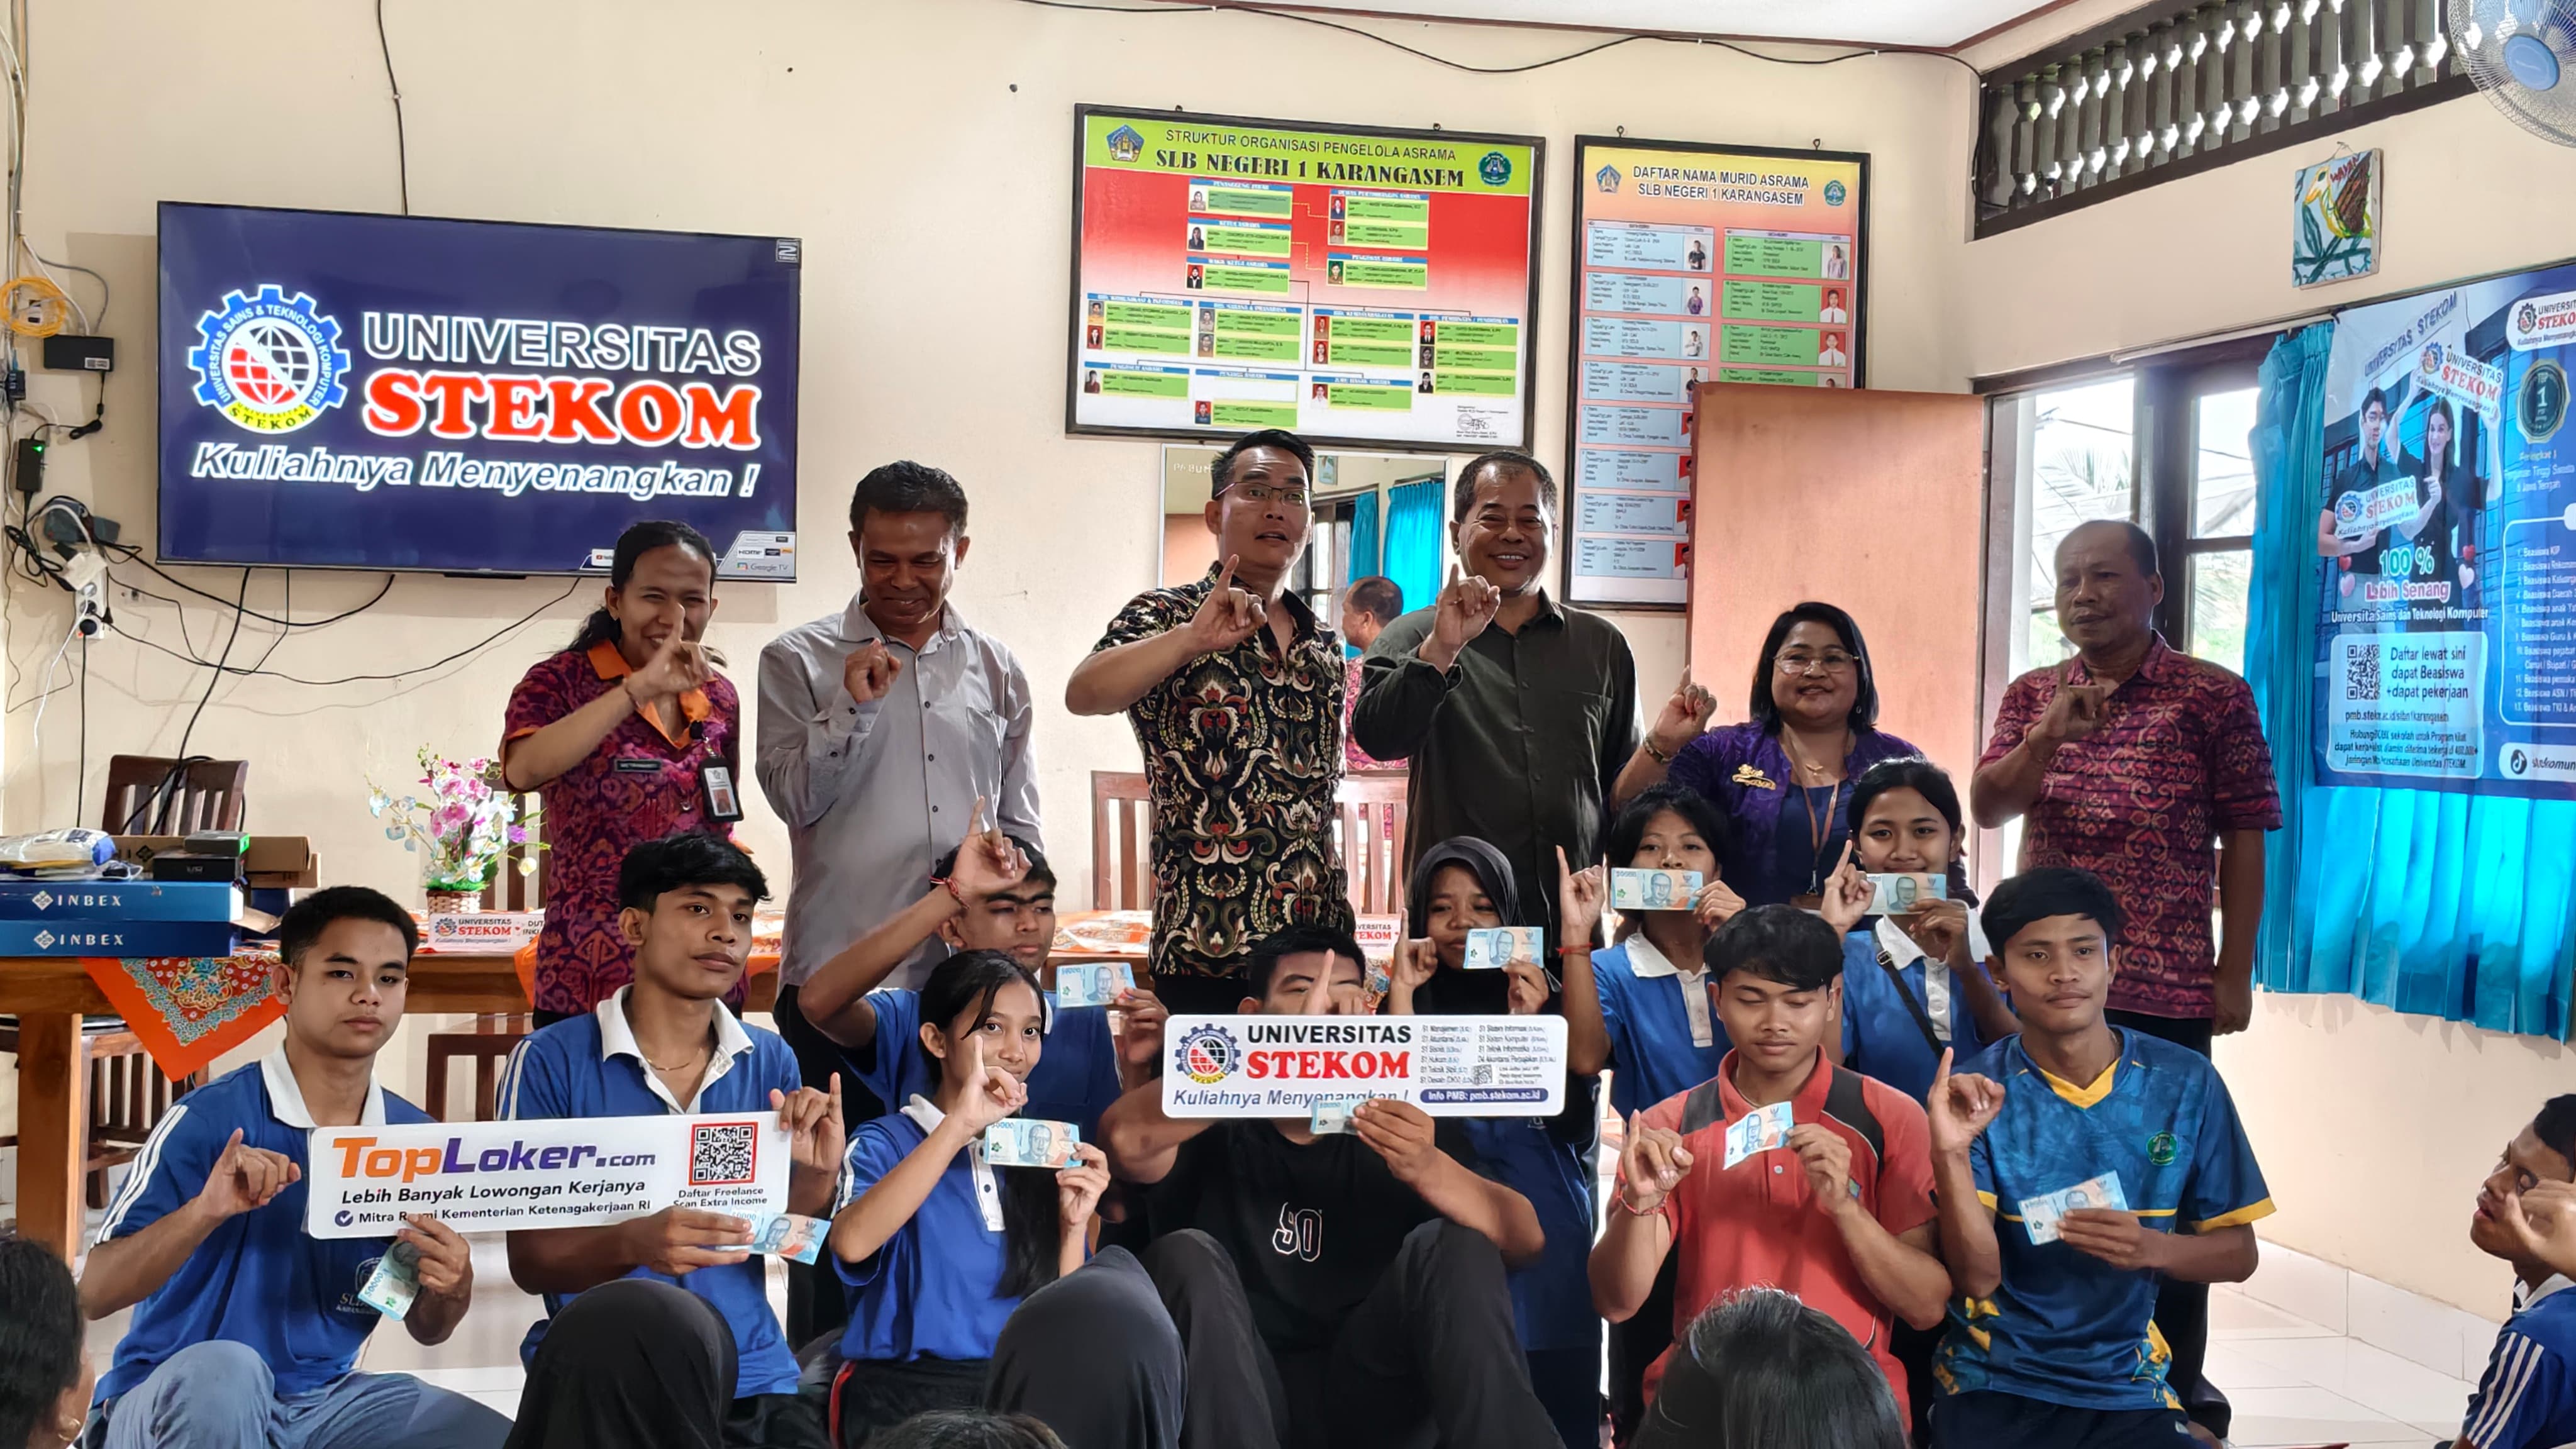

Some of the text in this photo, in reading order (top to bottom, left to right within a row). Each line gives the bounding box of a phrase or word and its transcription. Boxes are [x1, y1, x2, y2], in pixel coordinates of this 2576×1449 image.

[1166, 129, 1457, 161] STRUKTUR ORGANISASI PENGELOLA ASRAMA
[1157, 149, 1464, 187] SLB NEGERI 1 KARANGASEM
[1633, 166, 1809, 189] DAFTAR NAMA MURID ASRAMA
[1638, 184, 1804, 205] SLB NEGERI 1 KARANGASEM
[2538, 312, 2576, 330] STEKO
[364, 311, 762, 375] UNIVERSITAS
[2365, 291, 2457, 377] UNIVERSITAS STEKOM
[209, 304, 331, 406] UNIVERSITAS SAINS & TEKNOLOGI KOMPUTER
[2446, 350, 2502, 384] UNIVERSITAS
[2441, 365, 2498, 401] STEKOM
[2538, 386, 2547, 407] 1
[230, 408, 312, 430] STEKOM
[364, 368, 761, 450] STEKOM
[191, 441, 759, 501] Kuliahnya Menyenangkan !
[2380, 546, 2434, 577] 100 %
[2402, 580, 2451, 603] Senang
[2412, 606, 2446, 623] Teknologi
[2447, 606, 2489, 621] Komputer
[2390, 645, 2466, 660] Daftar lewat sini
[2392, 665, 2464, 682] dapat Beasiswa
[2422, 684, 2468, 702] pekerjaan
[57, 895, 121, 906] INBEX
[59, 935, 123, 946] INBEX
[458, 926, 511, 936] STEKOM
[1247, 1025, 1411, 1044] UNIVERSITAS
[1246, 1051, 1410, 1079] STEKOM
[1174, 1090, 1261, 1109] Kuliahnya
[1428, 1091, 1445, 1101] Info
[1470, 1091, 1540, 1102] pmb.stekom.ac.id
[333, 1136, 656, 1183] TopLoker.com
[342, 1180, 645, 1204] Lebih Banyak Lowongan Kerjanya
[674, 1197, 768, 1208] Scan Extra Income
[679, 1187, 764, 1198] Daftar Freelance
[359, 1200, 651, 1223] Mitra Rmi Kementerian Ketenagakerjaan RI
